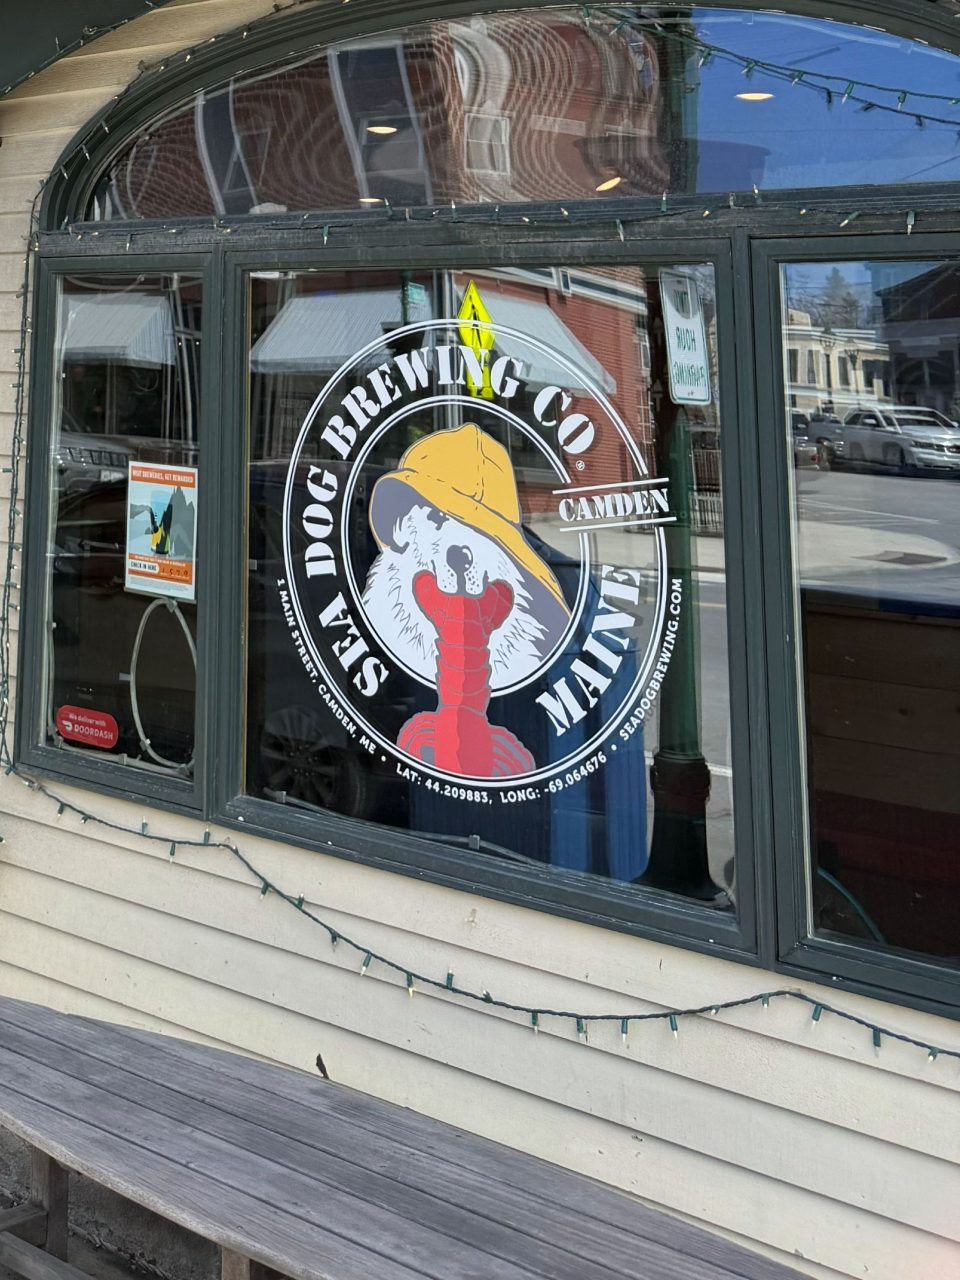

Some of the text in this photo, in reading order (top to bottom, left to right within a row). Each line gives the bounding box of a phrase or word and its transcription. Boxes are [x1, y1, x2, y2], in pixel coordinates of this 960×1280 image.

[302, 344, 595, 697] SEA DOG BREWING CO
[558, 487, 670, 522] CAMDEN
[276, 578, 377, 754] 1 MAIN STREET, CAMDEN, ME
[534, 563, 641, 737] MAINE
[619, 577, 683, 741] SEADOGBREWING.COM
[74, 723, 113, 740] DOORDASH
[78, 714, 95, 724] deliver
[395, 750, 607, 805] LAT: 44.209883, LONG: -69.064676
